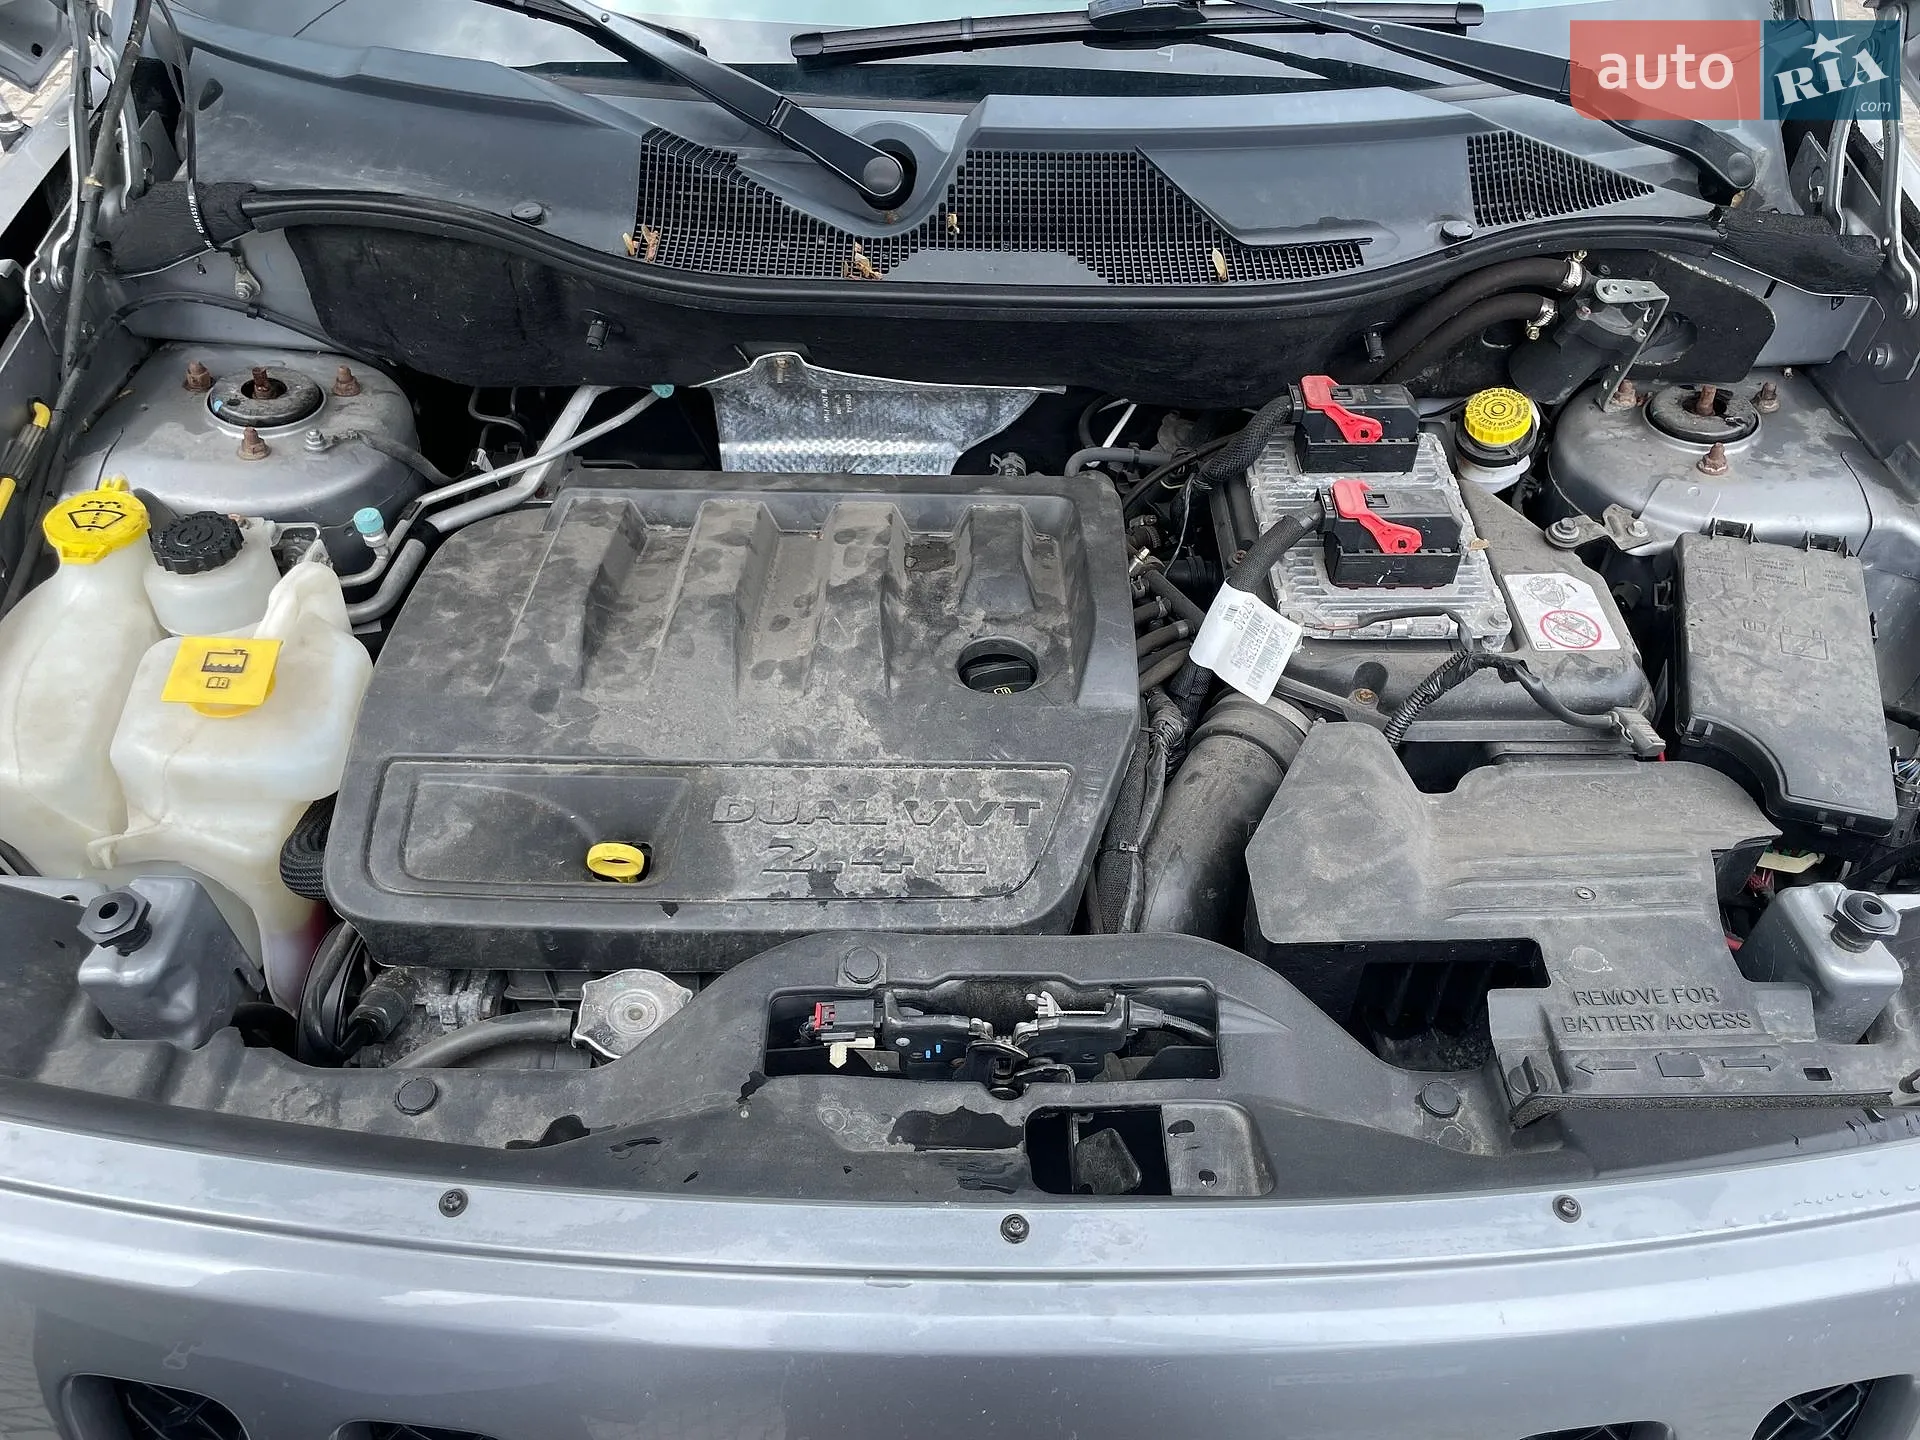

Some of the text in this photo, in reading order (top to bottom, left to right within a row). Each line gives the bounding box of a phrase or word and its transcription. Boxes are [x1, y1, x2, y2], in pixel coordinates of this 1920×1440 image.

[711, 799, 1042, 827] DUAL VVT
[1572, 987, 1721, 1006] REMOVE FOR
[1561, 1011, 1752, 1033] BATTERY ACCESS
